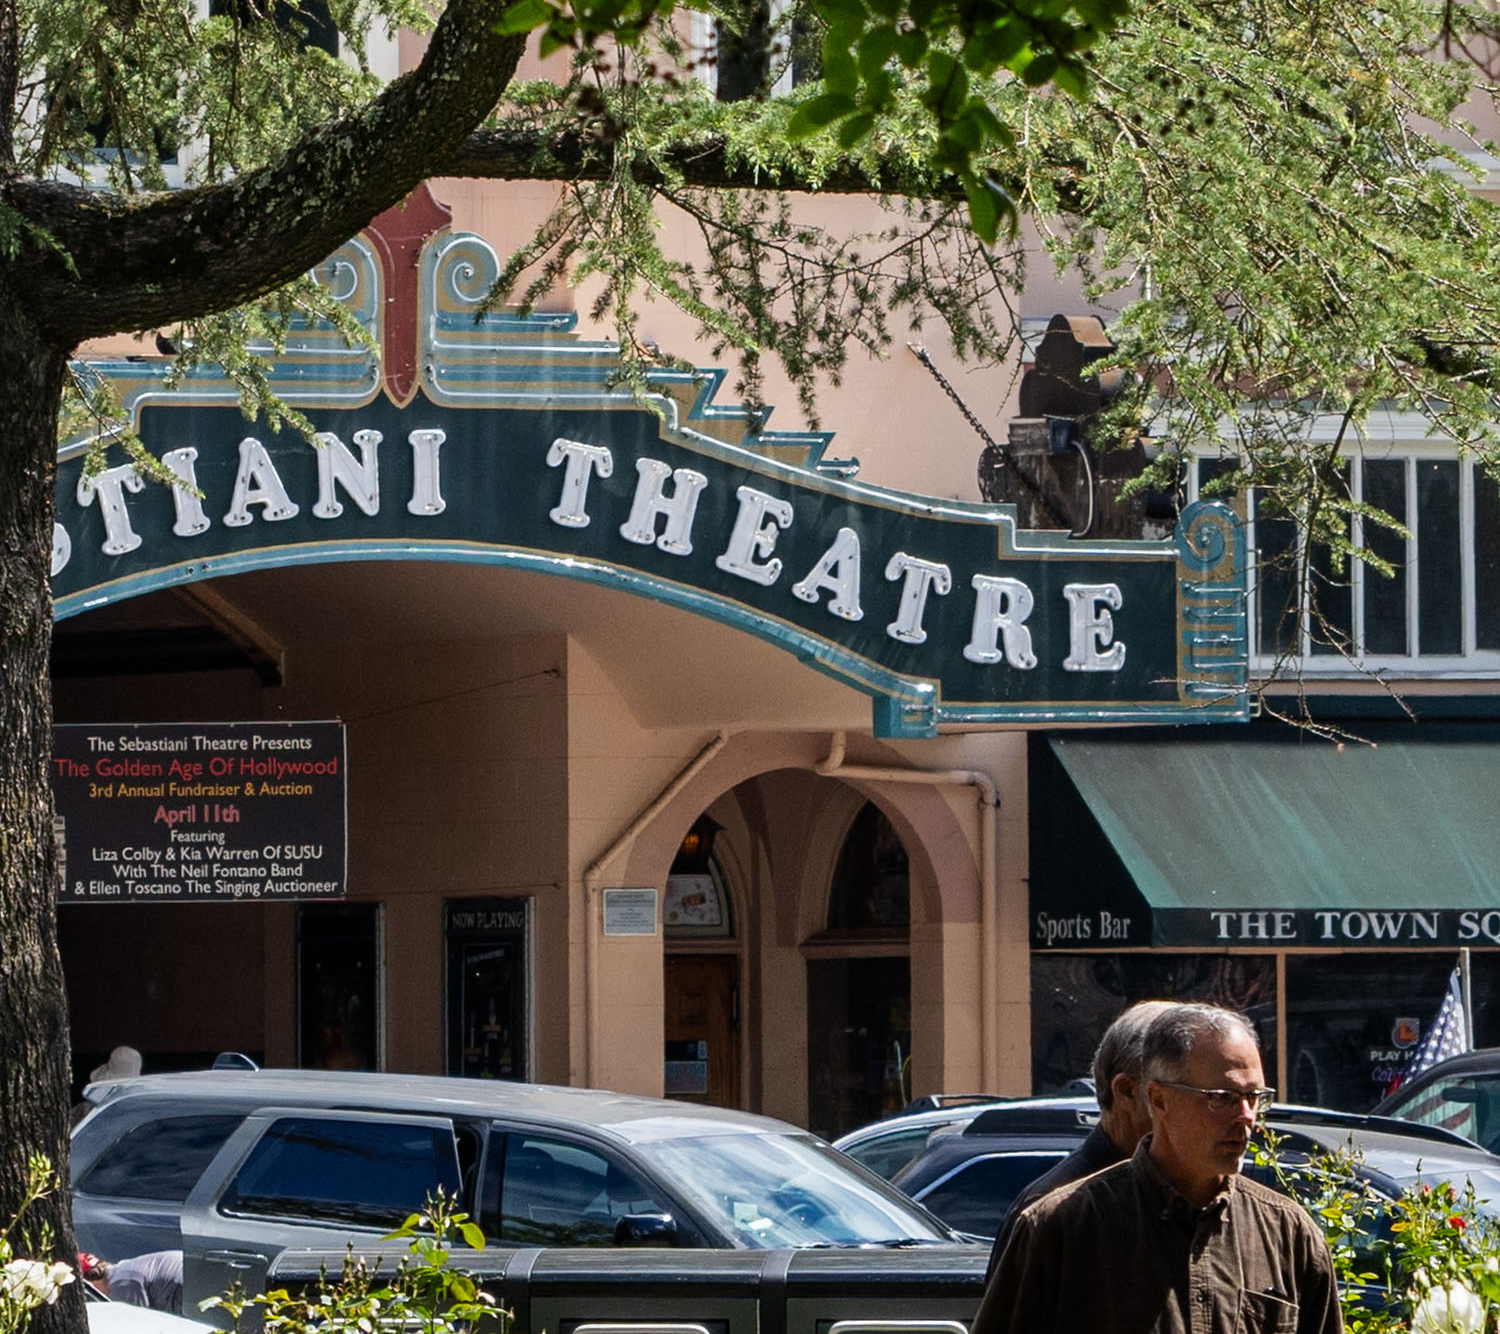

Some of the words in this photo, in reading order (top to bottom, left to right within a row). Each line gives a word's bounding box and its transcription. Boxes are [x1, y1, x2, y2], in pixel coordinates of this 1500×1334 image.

[546, 437, 1126, 672] THEATRE
[87, 736, 115, 751] The
[119, 736, 188, 752] Sebastiani
[192, 735, 248, 751] Theatre
[252, 734, 312, 751] Presents
[53, 758, 90, 777] The
[96, 757, 162, 777] Golden
[168, 758, 203, 781] Age
[209, 756, 235, 776] Of
[240, 756, 338, 780] Hollywood
[89, 783, 113, 798] 3rd
[117, 783, 164, 797] Annual
[169, 782, 240, 797] Fundraiser
[244, 781, 256, 796] &
[259, 782, 313, 796] Auction
[153, 804, 196, 828] April
[203, 804, 240, 823] 11th
[170, 829, 225, 845] Featuring
[92, 847, 118, 861] Liza
[122, 846, 162, 865] Colby
[165, 847, 176, 861] &
[180, 846, 202, 861] Kia
[205, 846, 259, 860] Warren
[263, 845, 281, 860] Of
[284, 844, 323, 860] SUSU
[112, 864, 147, 878] With
[150, 864, 177, 878] The
[180, 864, 209, 878] Neil
[212, 863, 267, 878] Fontano
[271, 862, 303, 877] Band
[74, 881, 85, 895] &
[89, 880, 121, 895] Ellen
[125, 880, 182, 894] Toscano
[185, 880, 211, 894] The
[214, 879, 260, 897] Singing
[263, 878, 339, 893] Auctioneer
[452, 912, 475, 929] NOW
[477, 910, 524, 929] PLAYING
[1036, 911, 1091, 946] Sports
[1100, 911, 1131, 940] Bar
[1210, 911, 1297, 939] THE
[1315, 911, 1440, 939] TOWN
[1370, 1050, 1401, 1061] PLAY
